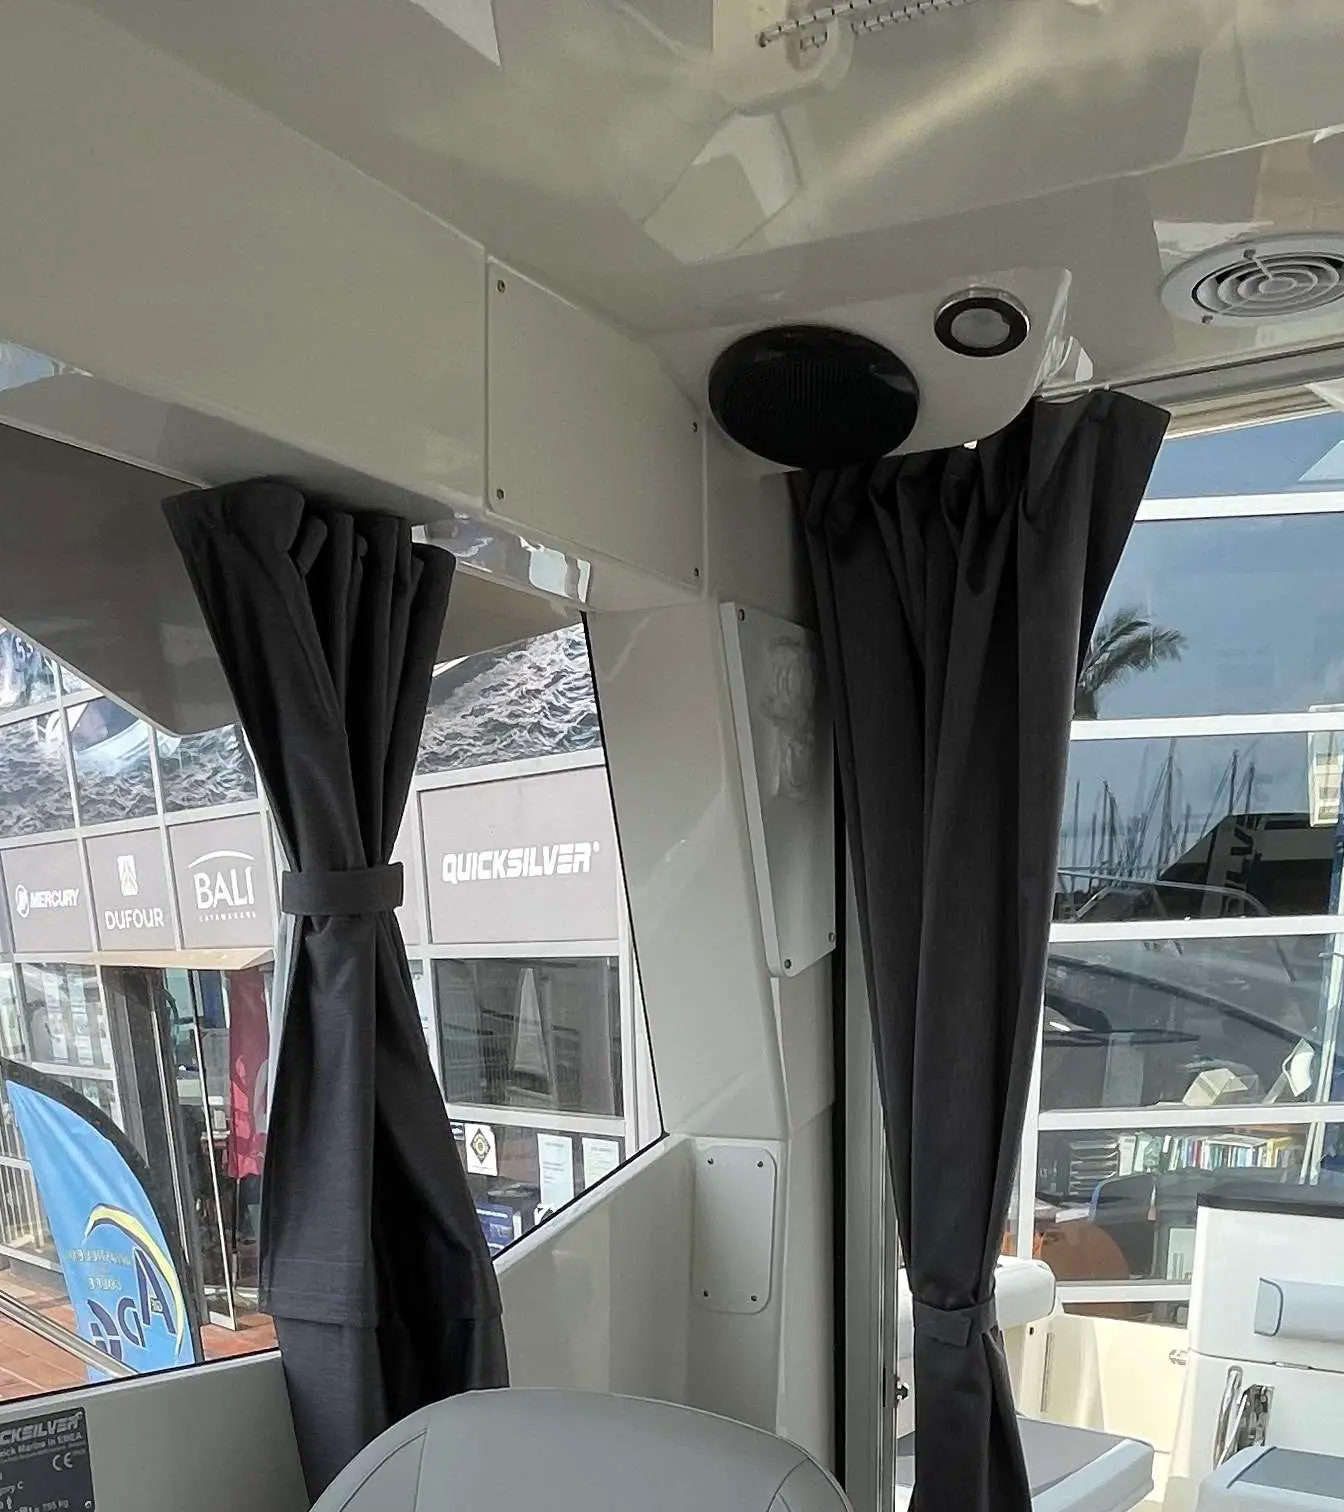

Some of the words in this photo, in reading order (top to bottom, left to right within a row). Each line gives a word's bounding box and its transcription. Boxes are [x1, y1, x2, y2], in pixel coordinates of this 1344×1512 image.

[442, 842, 593, 885] QUICKSILVER
[29, 888, 80, 909] MERCURY
[193, 866, 256, 910] BALI
[105, 908, 165, 931] DUFOUR
[16, 1480, 25, 1491] C
